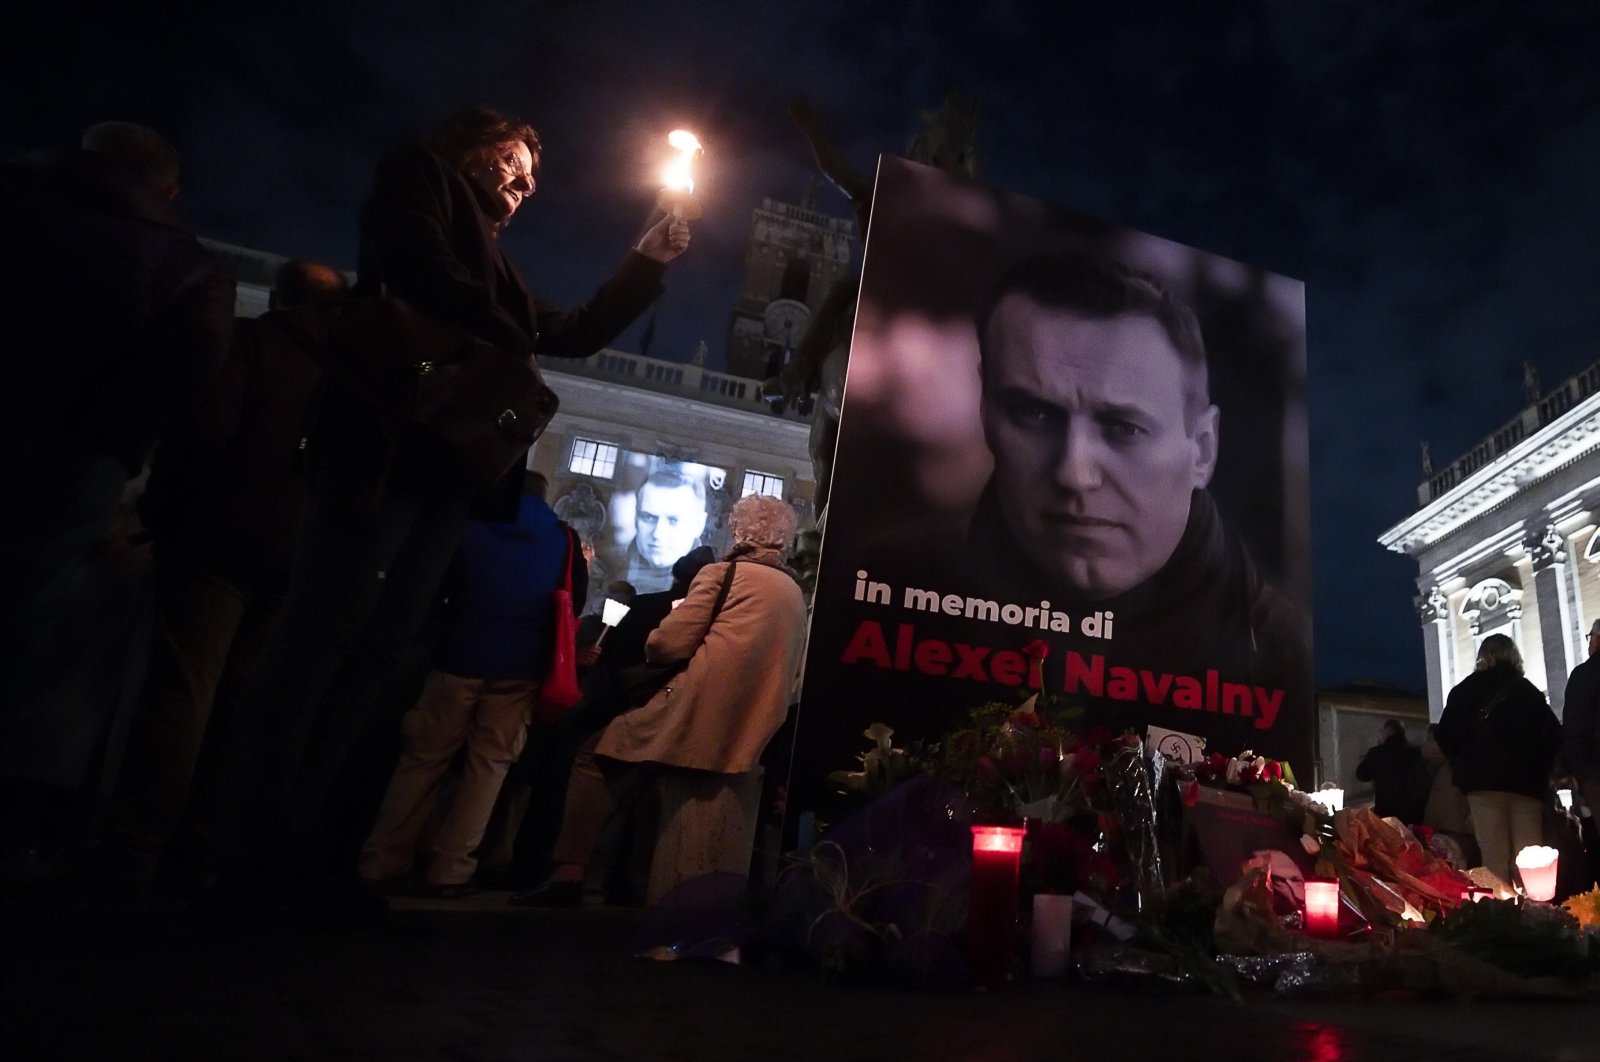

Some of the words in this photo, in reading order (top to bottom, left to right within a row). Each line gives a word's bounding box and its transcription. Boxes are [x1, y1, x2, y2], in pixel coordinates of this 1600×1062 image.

[854, 570, 892, 605] in
[903, 587, 1070, 633] memoria
[1080, 610, 1114, 640] di
[1064, 650, 1285, 729] Navalny
